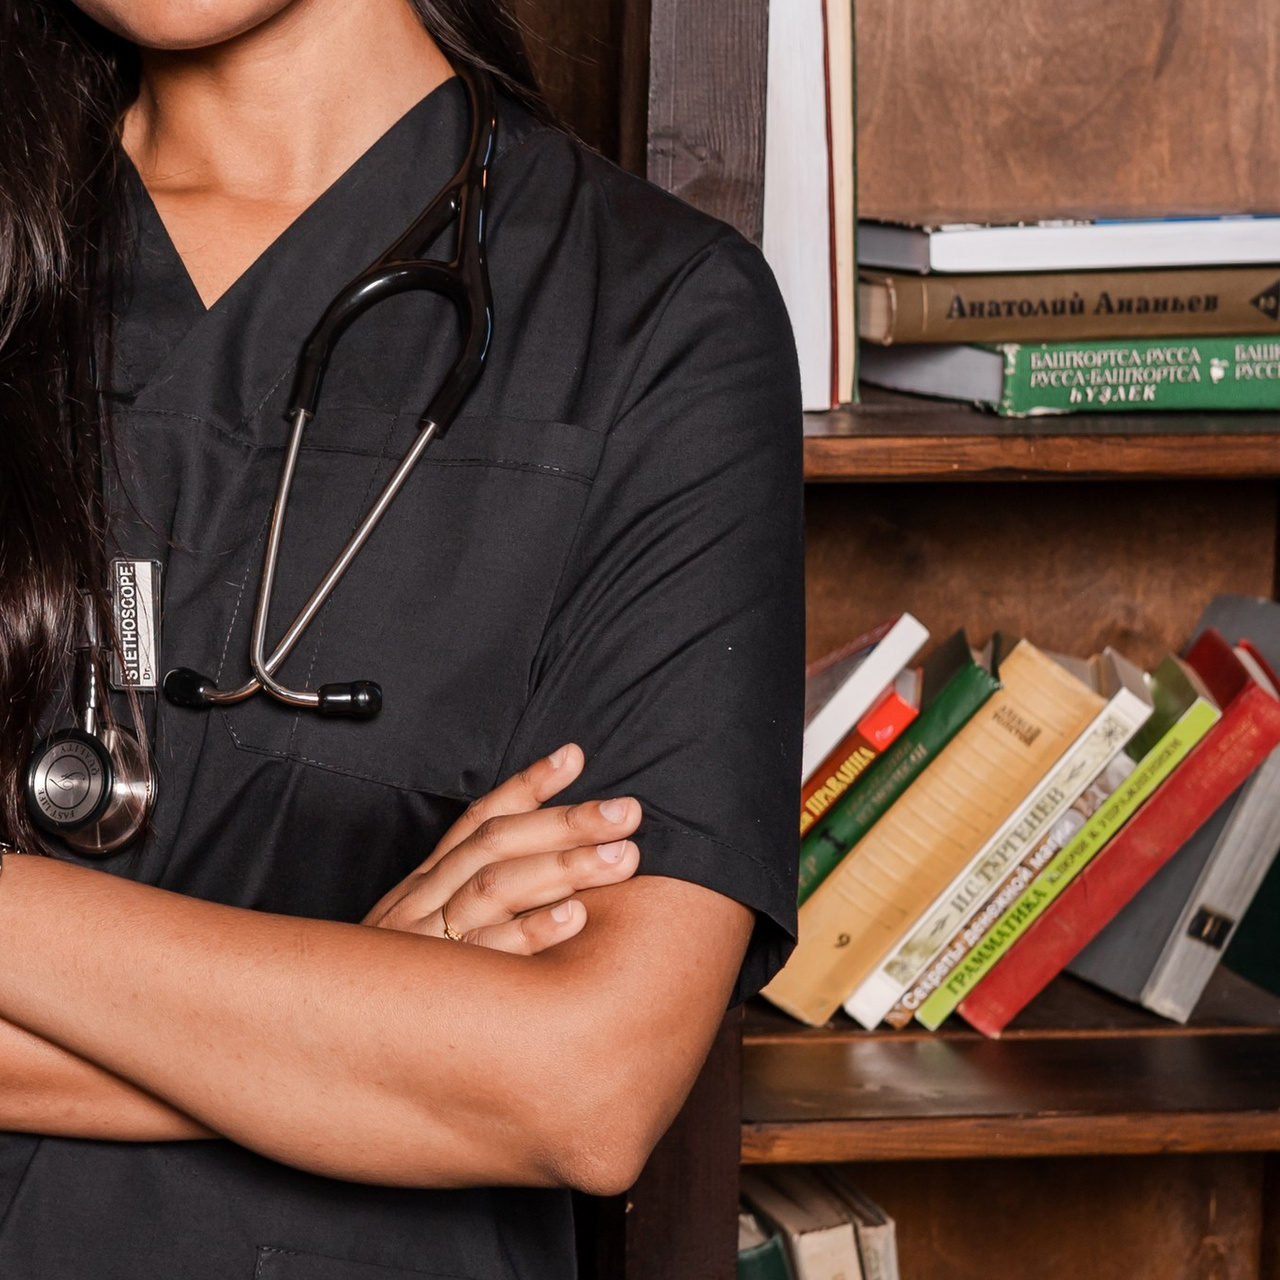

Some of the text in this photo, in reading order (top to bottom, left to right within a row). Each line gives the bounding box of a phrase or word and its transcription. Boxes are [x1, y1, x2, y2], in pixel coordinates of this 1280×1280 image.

[947, 291, 1220, 320] Анатолий Ананьев
[119, 565, 138, 681] STETHOSCOPE
[899, 937, 968, 1015] Секреты
[959, 862, 1036, 948] денежной
[945, 885, 1048, 996] ГРАММАТИКА
